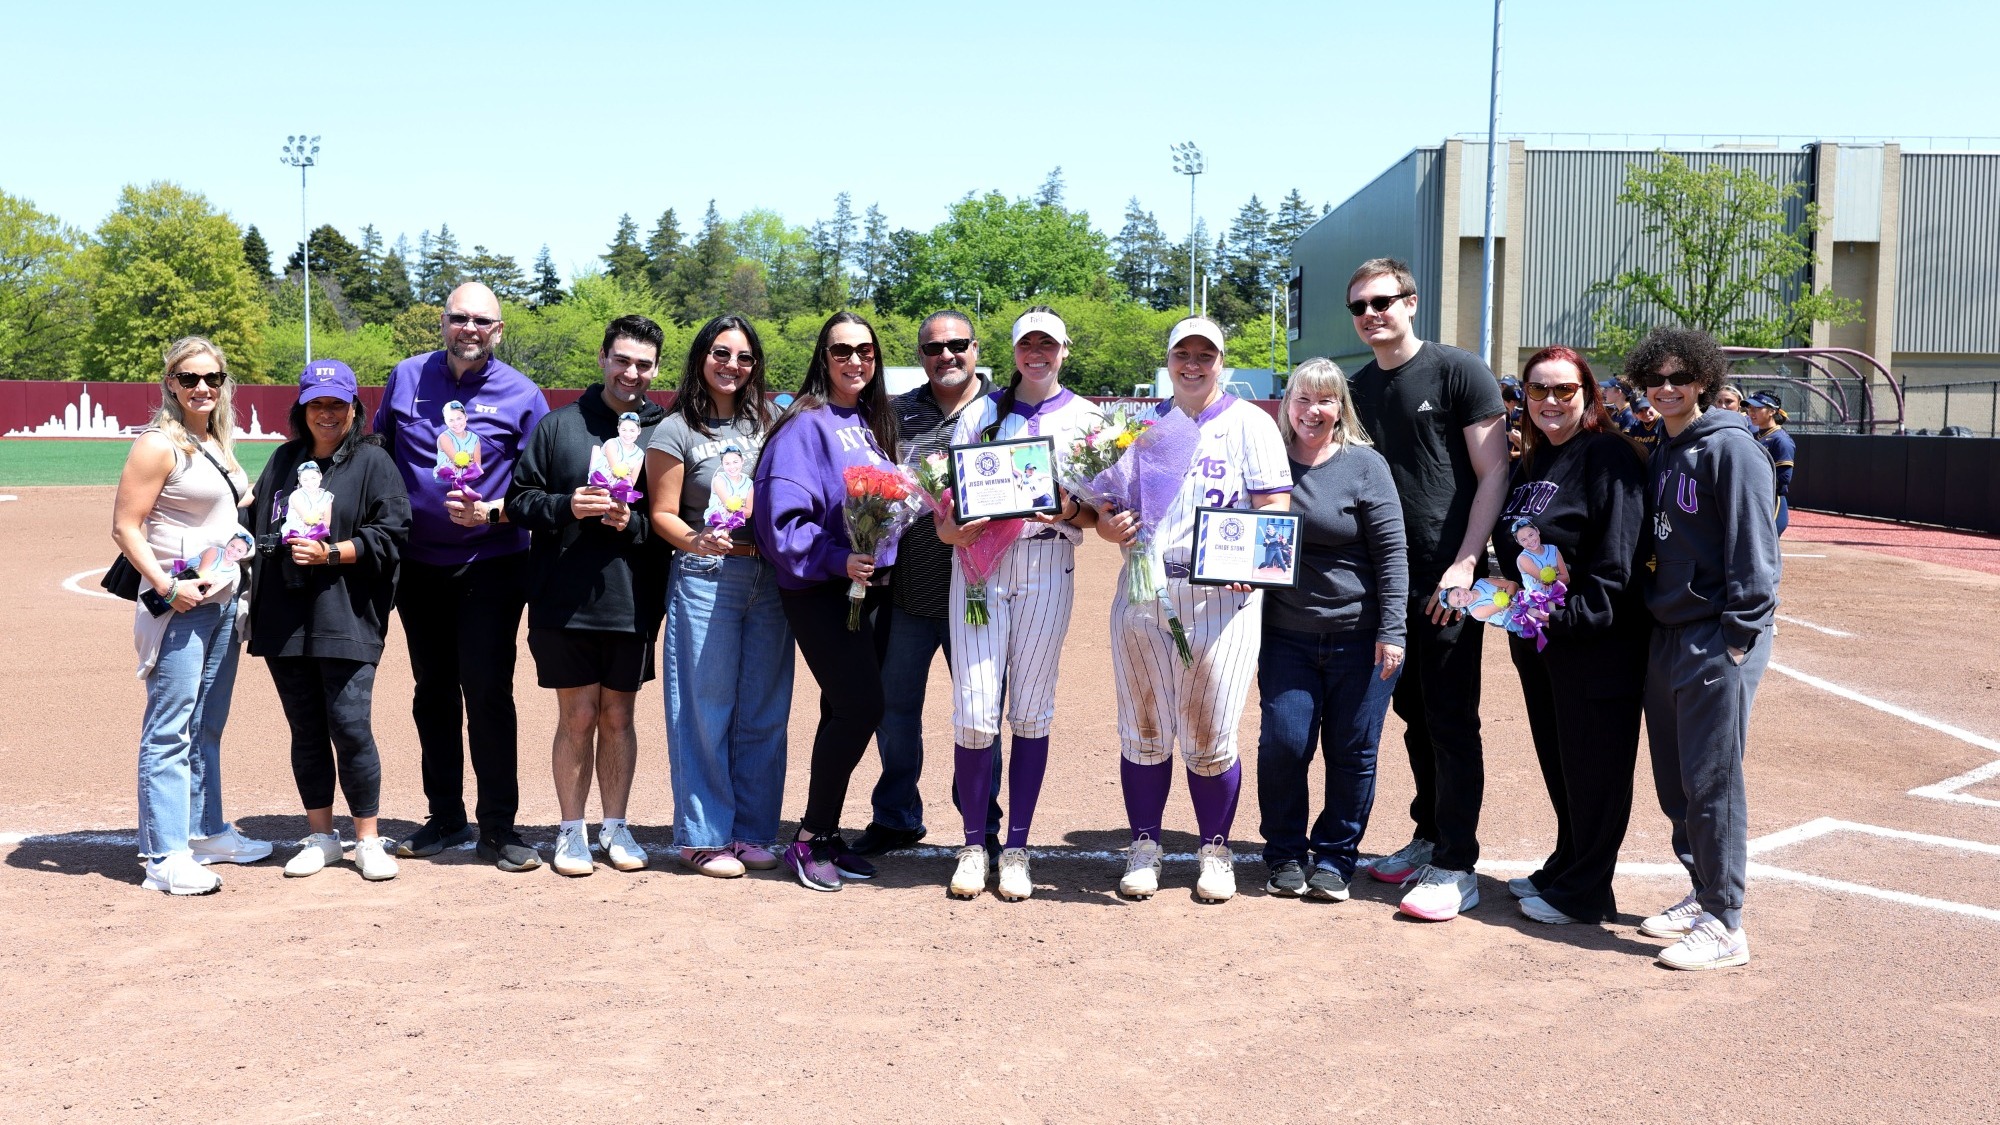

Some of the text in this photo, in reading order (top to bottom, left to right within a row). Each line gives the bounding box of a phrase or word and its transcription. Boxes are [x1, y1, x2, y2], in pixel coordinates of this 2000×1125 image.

[316, 367, 335, 376] NYU
[475, 404, 498, 414] NYU
[836, 426, 877, 452] NY
